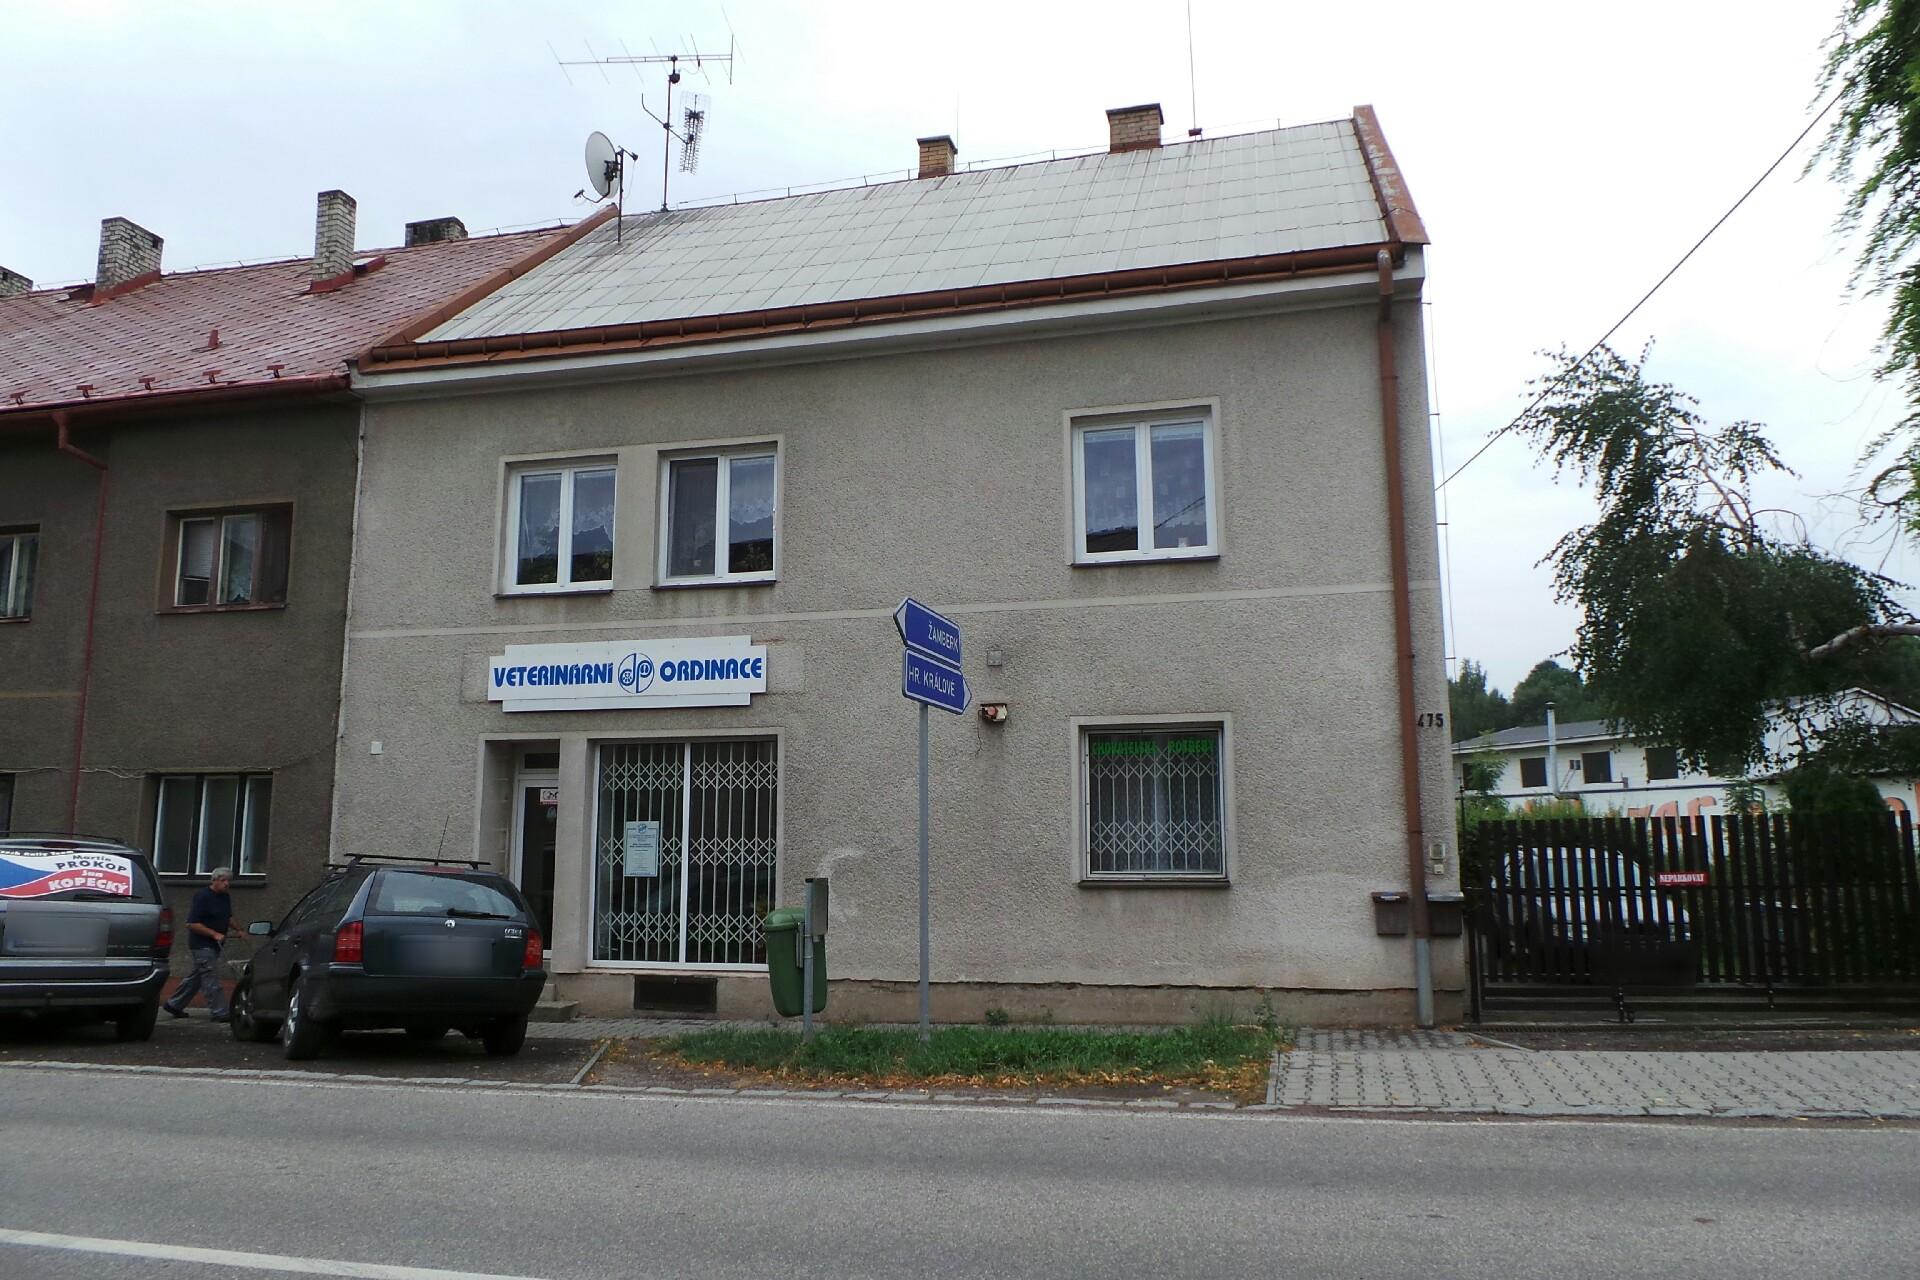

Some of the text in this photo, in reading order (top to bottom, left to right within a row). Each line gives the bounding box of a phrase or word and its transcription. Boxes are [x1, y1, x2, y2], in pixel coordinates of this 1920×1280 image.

[928, 620, 959, 652] ŽAMBERK
[494, 657, 762, 687] VETERINÁRNÍ ORDINACE
[908, 665, 955, 696] HR KRÁLOVÉ
[1418, 713, 1443, 727] 475
[56, 860, 127, 872] PROKOP
[81, 869, 104, 878] Jan
[48, 877, 128, 894] KOPECKÝ
